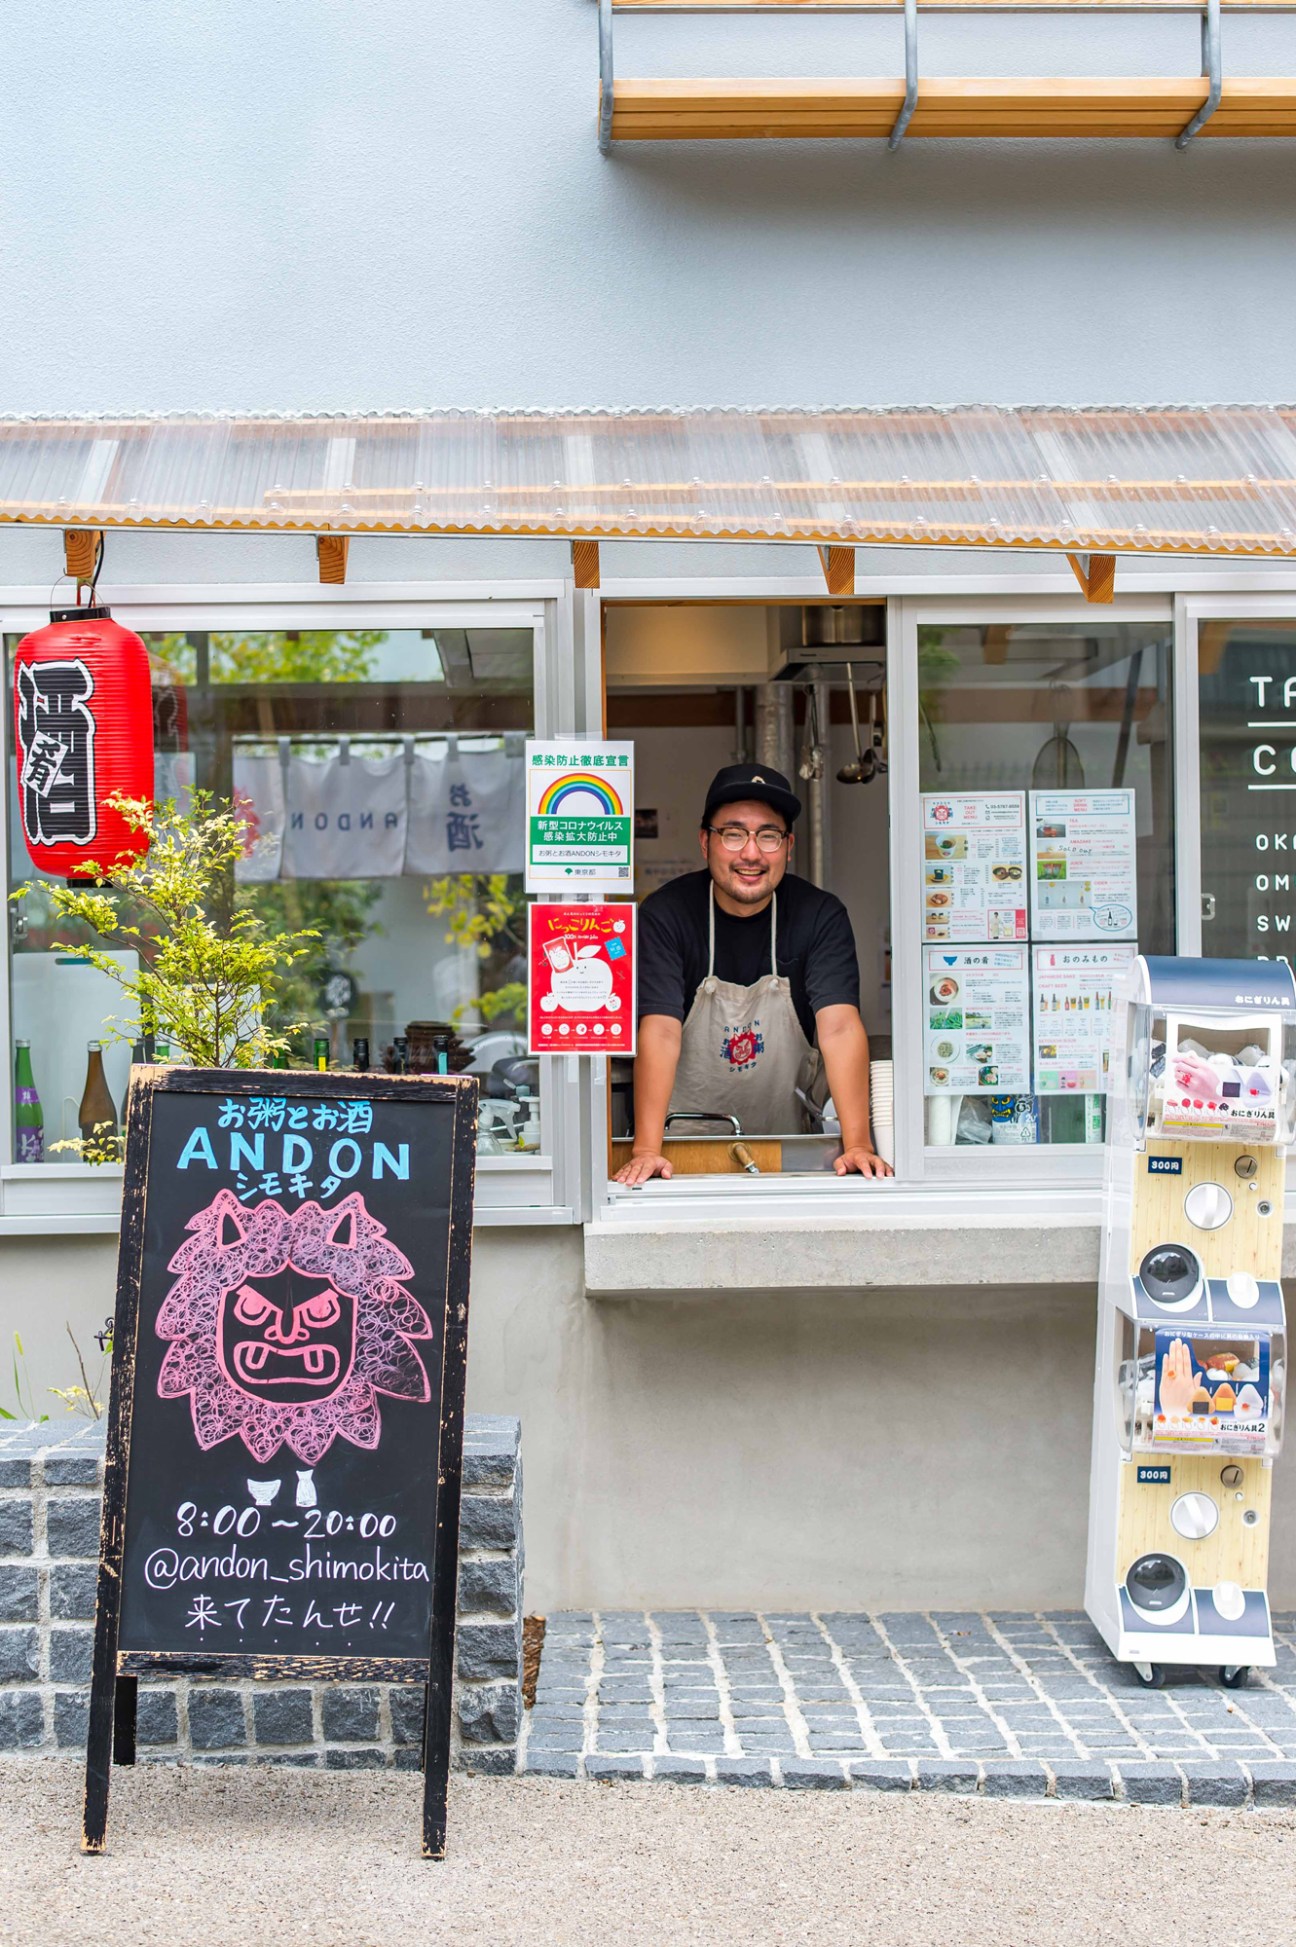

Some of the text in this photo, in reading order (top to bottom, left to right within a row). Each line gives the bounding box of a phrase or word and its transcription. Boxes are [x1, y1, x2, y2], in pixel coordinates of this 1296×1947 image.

[531, 754, 629, 767] 感染防止徹底宣言
[537, 820, 624, 831] 新型コロナウイルス
[543, 832, 618, 842] 感染拡大防止中
[1255, 834, 1296, 851] OK
[574, 868, 597, 876] 東京都
[547, 918, 615, 933] にっこりんご
[1062, 955, 1108, 964] おのみもの
[218, 1097, 374, 1134] お粥とお酒
[176, 1126, 410, 1181] ANDON
[236, 1171, 342, 1201] シモキタ
[144, 1543, 430, 1590] @andon_shimokita
